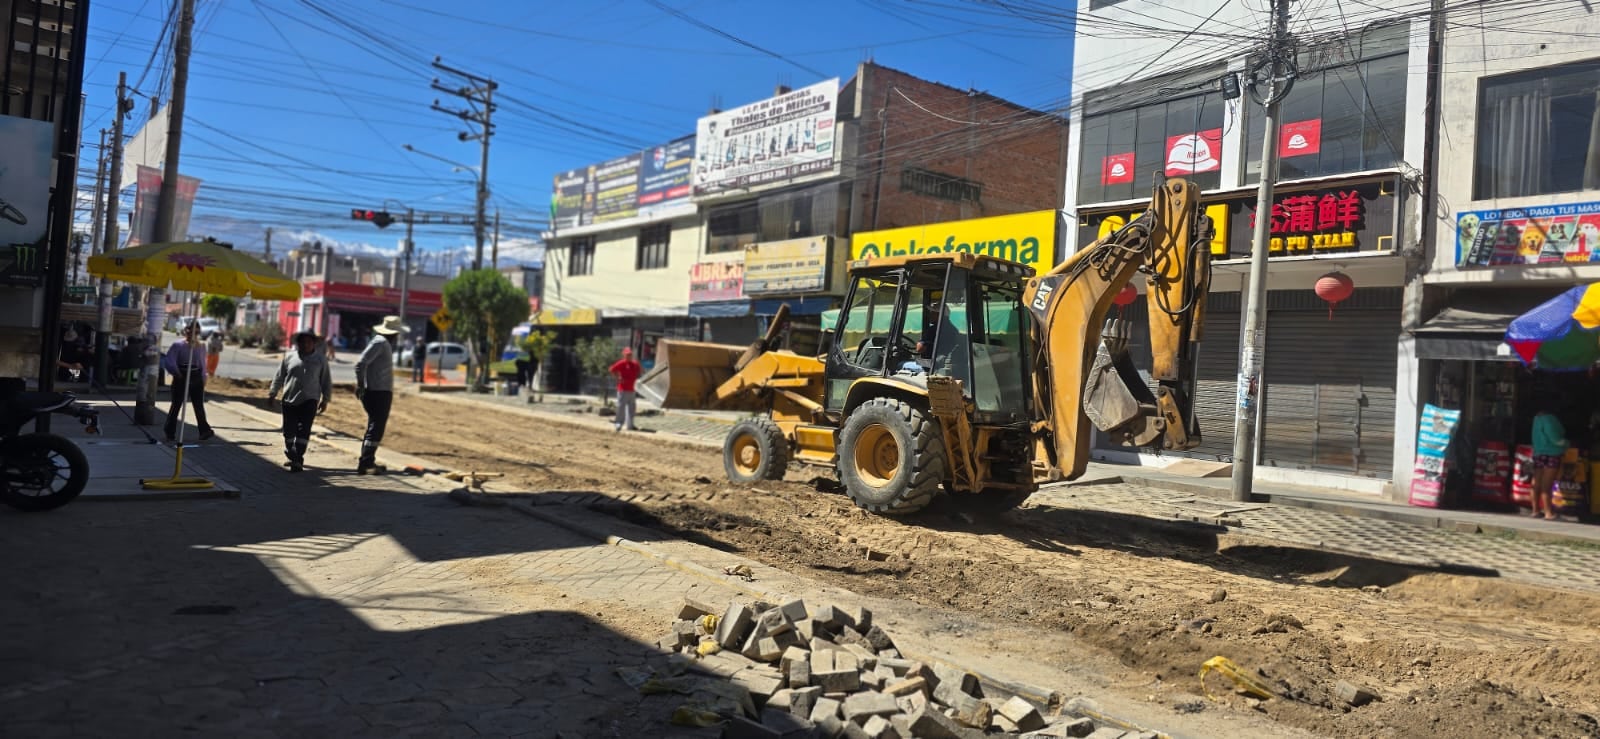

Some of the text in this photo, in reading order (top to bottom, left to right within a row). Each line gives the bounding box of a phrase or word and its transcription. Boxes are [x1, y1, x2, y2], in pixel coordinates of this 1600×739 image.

[731, 94, 825, 126] Thales de Mileto
[760, 101, 770, 110] DE
[772, 89, 811, 107] CIENCIAS
[1484, 212, 1496, 220] LO
[1529, 207, 1555, 216] PARA
[1559, 206, 1575, 214] TUS
[1577, 203, 1600, 213] MAS
[1312, 231, 1355, 248] XIAN
[1033, 282, 1053, 311] CAT
